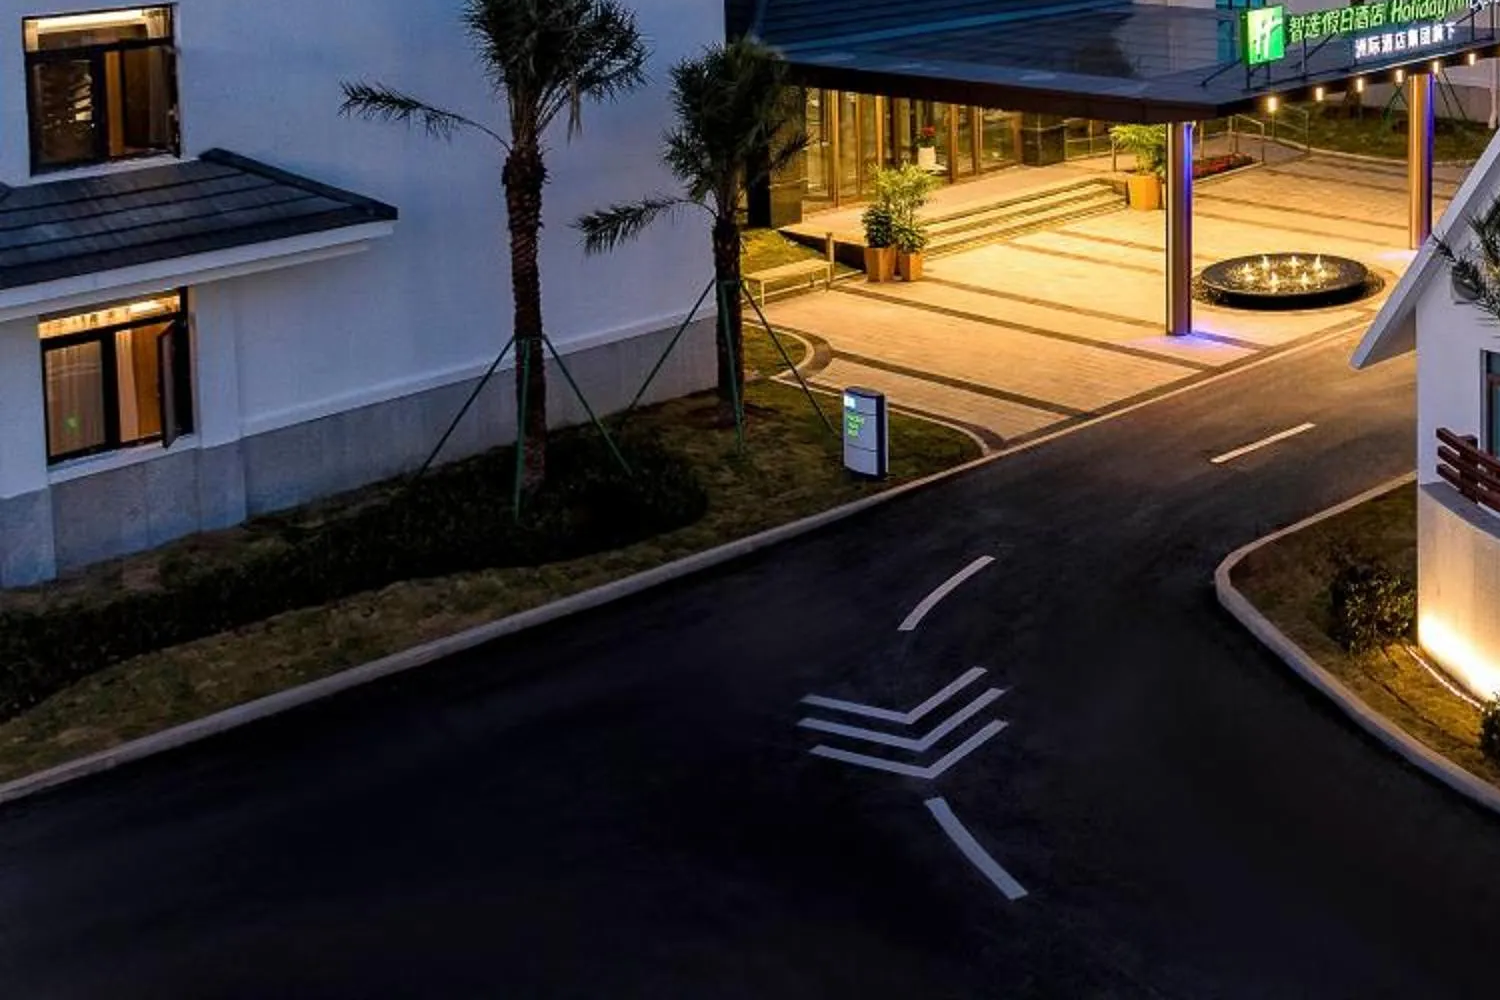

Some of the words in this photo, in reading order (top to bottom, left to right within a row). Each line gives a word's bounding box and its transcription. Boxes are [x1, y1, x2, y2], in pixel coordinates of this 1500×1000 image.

[1288, 2, 1386, 43] 智选假日酒店
